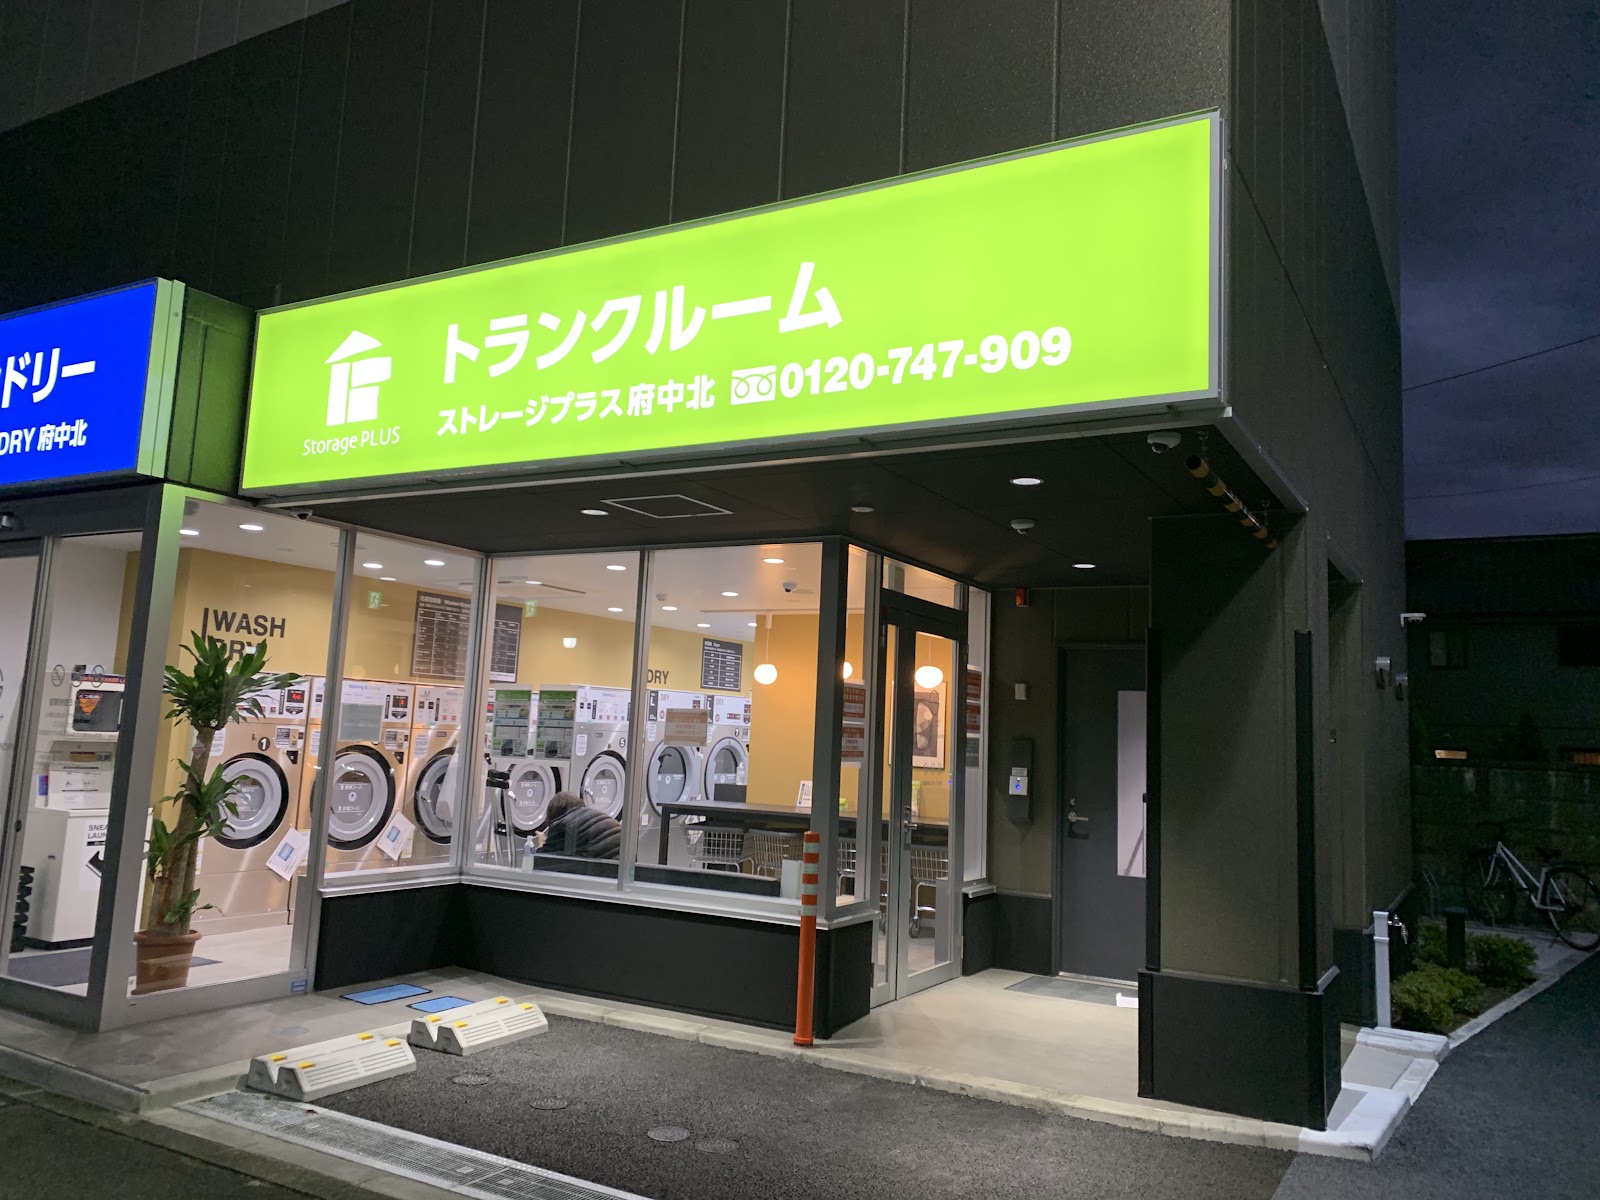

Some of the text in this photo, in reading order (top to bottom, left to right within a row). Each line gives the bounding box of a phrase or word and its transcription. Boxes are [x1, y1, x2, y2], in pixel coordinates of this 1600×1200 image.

[443, 262, 842, 384] トランクルーム
[0, 347, 96, 409] ドリー
[779, 326, 1072, 399] 0120-747-909
[37, 418, 89, 452] 府中北
[302, 425, 401, 456] Storage PLUS
[212, 609, 286, 638] WASH
